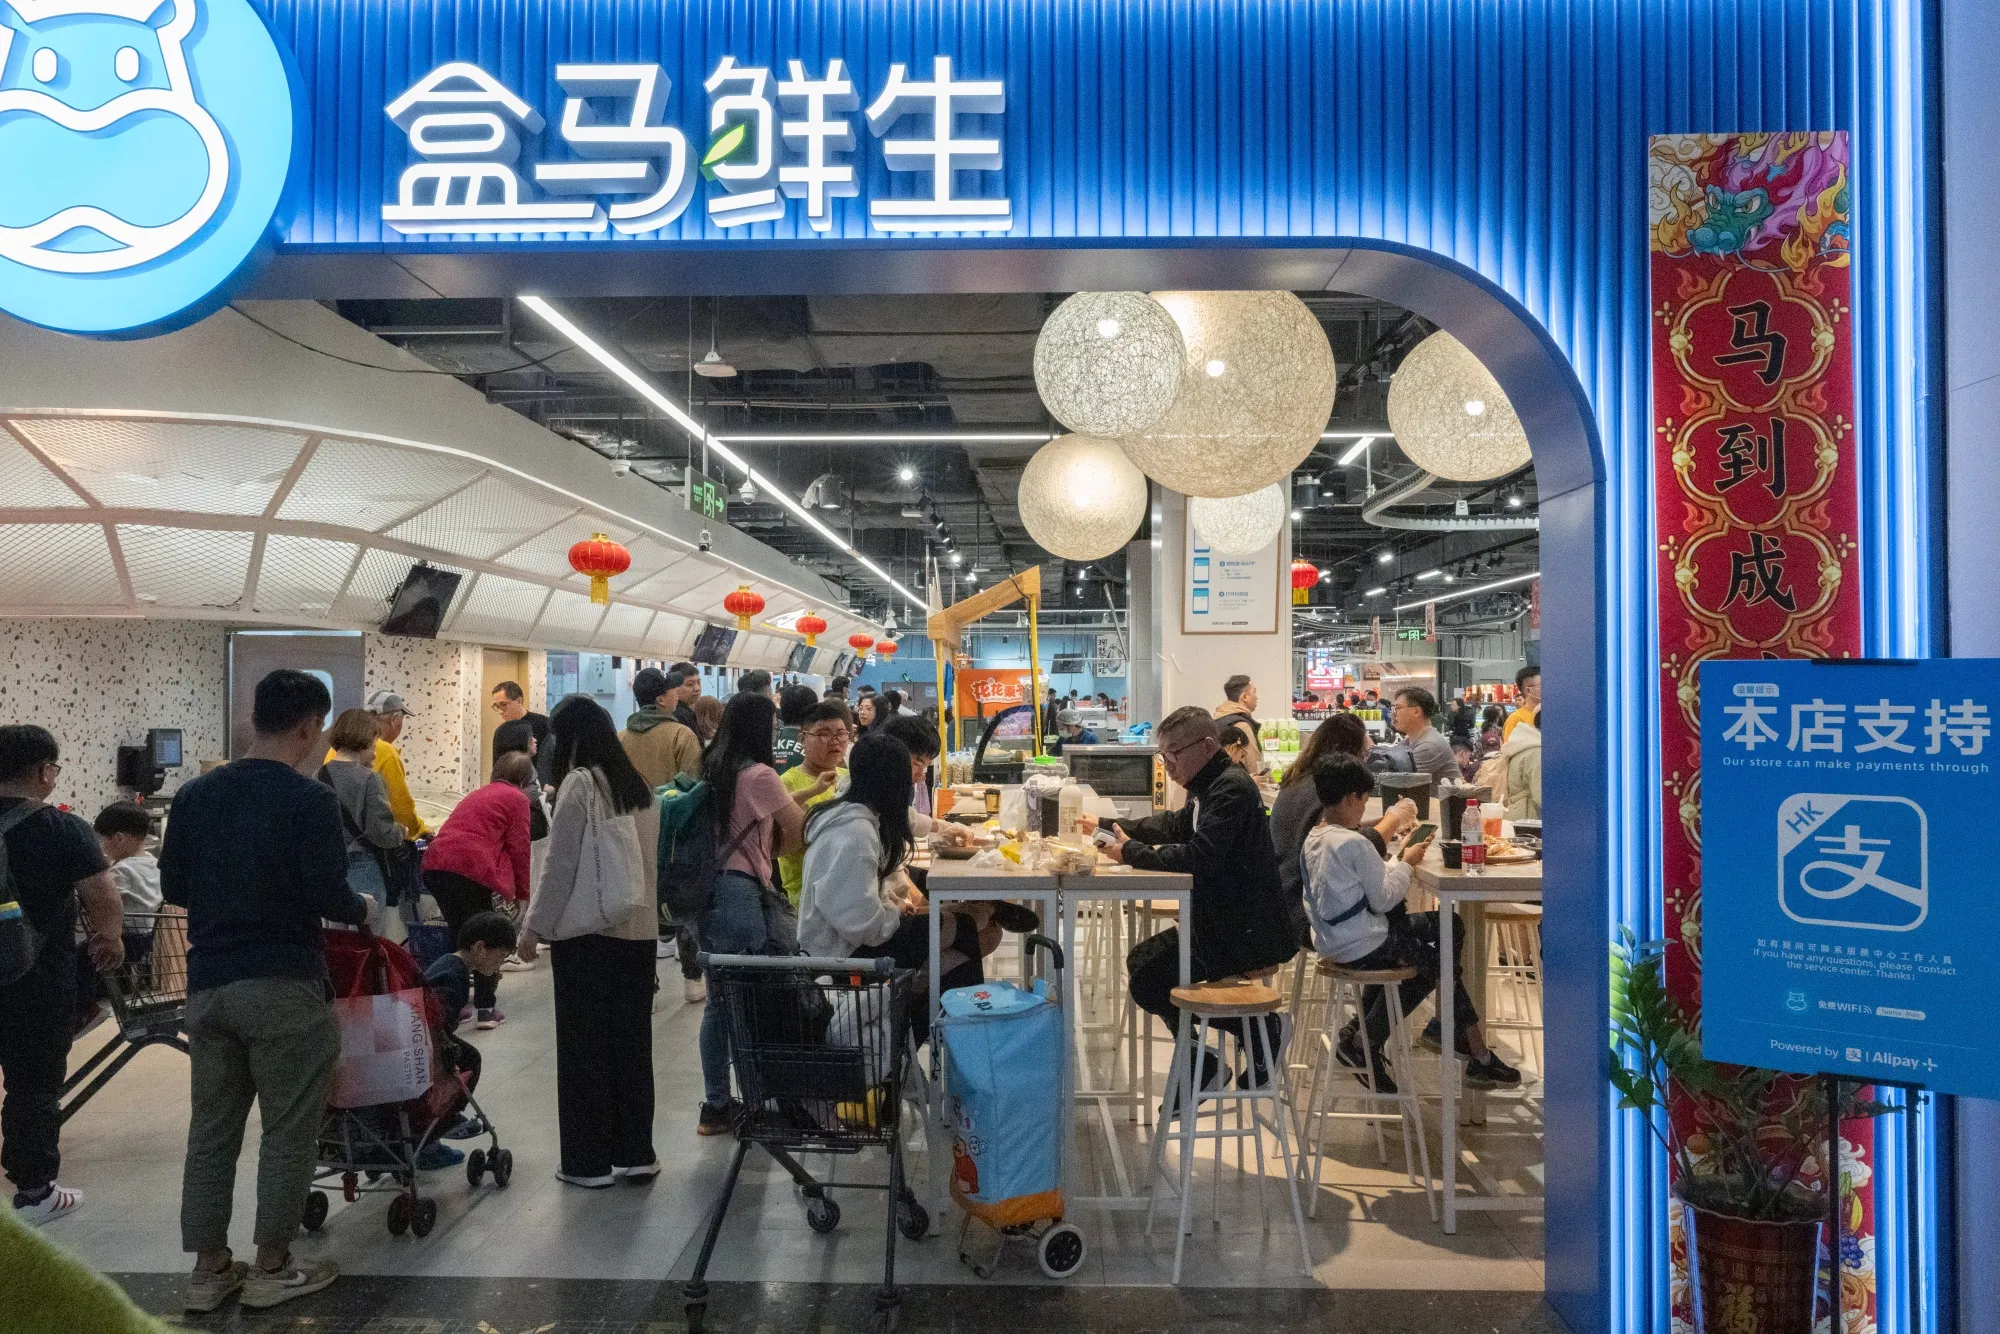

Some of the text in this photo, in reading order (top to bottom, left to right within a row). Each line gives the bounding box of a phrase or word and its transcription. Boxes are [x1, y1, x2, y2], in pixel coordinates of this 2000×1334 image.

[382, 55, 1013, 231] 盒马鲜生
[1713, 300, 1797, 660] 马到成
[1722, 698, 1991, 756] 本店支持
[1723, 757, 1989, 775] Our store can make payments through
[1785, 800, 1824, 835] HK
[1753, 948, 1957, 975] If you have any questions, please contact
[1786, 961, 1802, 969] the
[1804, 963, 1838, 973] service
[1839, 967, 1873, 977] center.
[410, 1002, 426, 1085] XIANG SHAN
[1770, 1039, 1821, 1055] Powered
[1824, 1046, 1839, 1059] by
[404, 1051, 412, 1085] PASTRY
